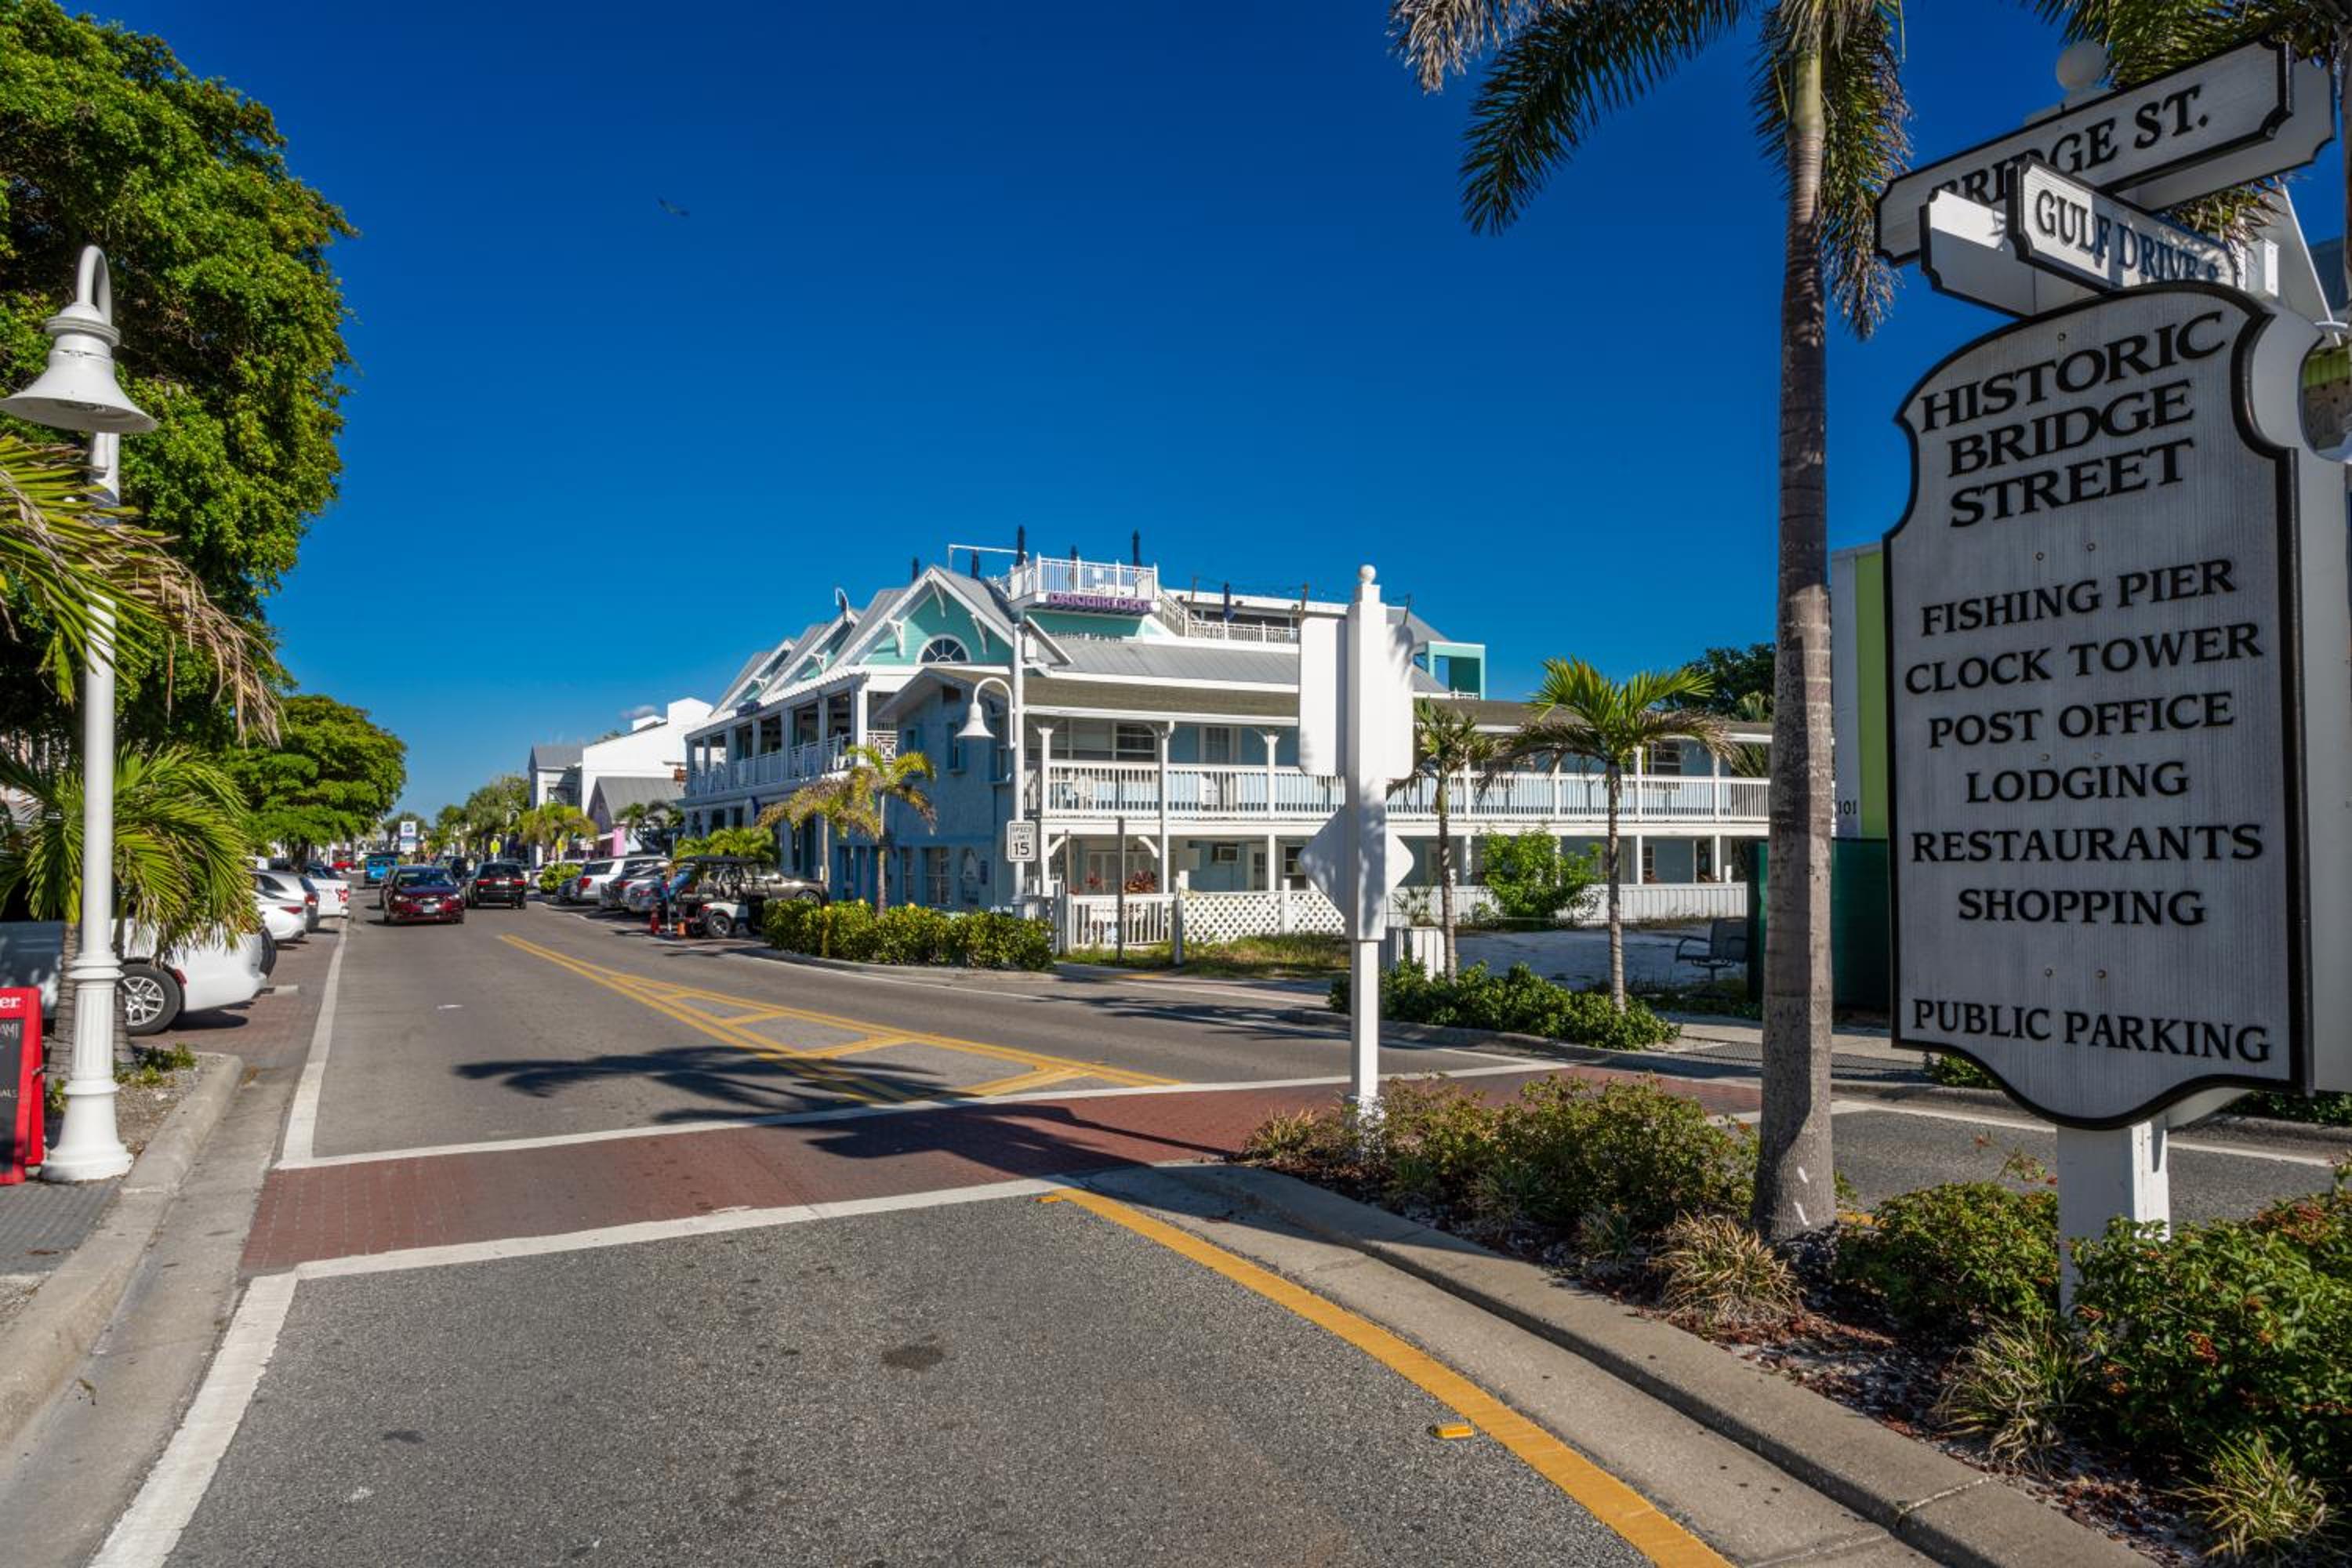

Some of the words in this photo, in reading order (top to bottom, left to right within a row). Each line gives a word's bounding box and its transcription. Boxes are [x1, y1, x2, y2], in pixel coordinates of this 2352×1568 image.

[2134, 84, 2209, 149] ST.
[2035, 189, 2111, 259] GULF
[1920, 311, 2226, 433] HISTORIC
[1947, 379, 2194, 477] BRIDGE
[1950, 437, 2194, 528] STREET
[1921, 579, 2100, 637] FISHING
[2118, 558, 2236, 608] PIER
[1905, 648, 2052, 695] CLOCK
[2068, 622, 2263, 676] TOWER
[1929, 709, 2043, 748] POST
[2058, 691, 2234, 738] OFFICE
[1966, 761, 2189, 803] LODGING
[1014, 841, 1029, 855] 15
[1911, 824, 2263, 862] RESTAURANTS
[1958, 889, 2206, 926] SHOPPING
[1913, 999, 2052, 1041] PUBLIC
[2064, 1011, 2270, 1063] PARKING
